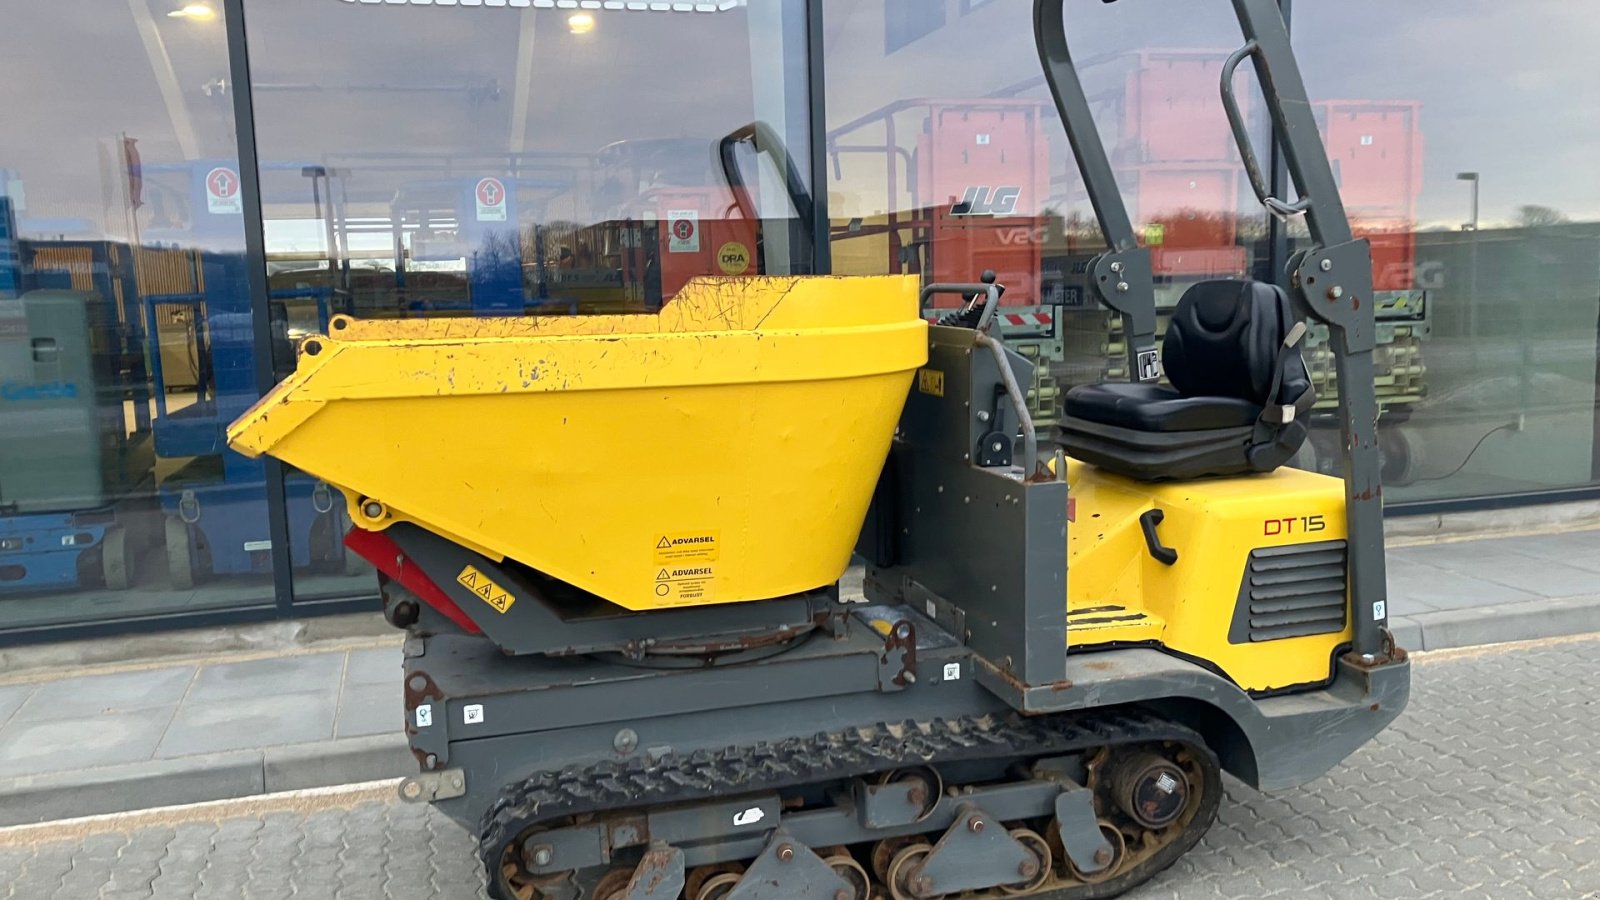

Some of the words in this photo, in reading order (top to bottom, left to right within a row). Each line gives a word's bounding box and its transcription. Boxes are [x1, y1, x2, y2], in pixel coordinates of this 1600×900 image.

[949, 185, 1022, 215] JLG
[672, 536, 715, 545] ADVARSEL
[672, 568, 712, 576] ADVARSEL
